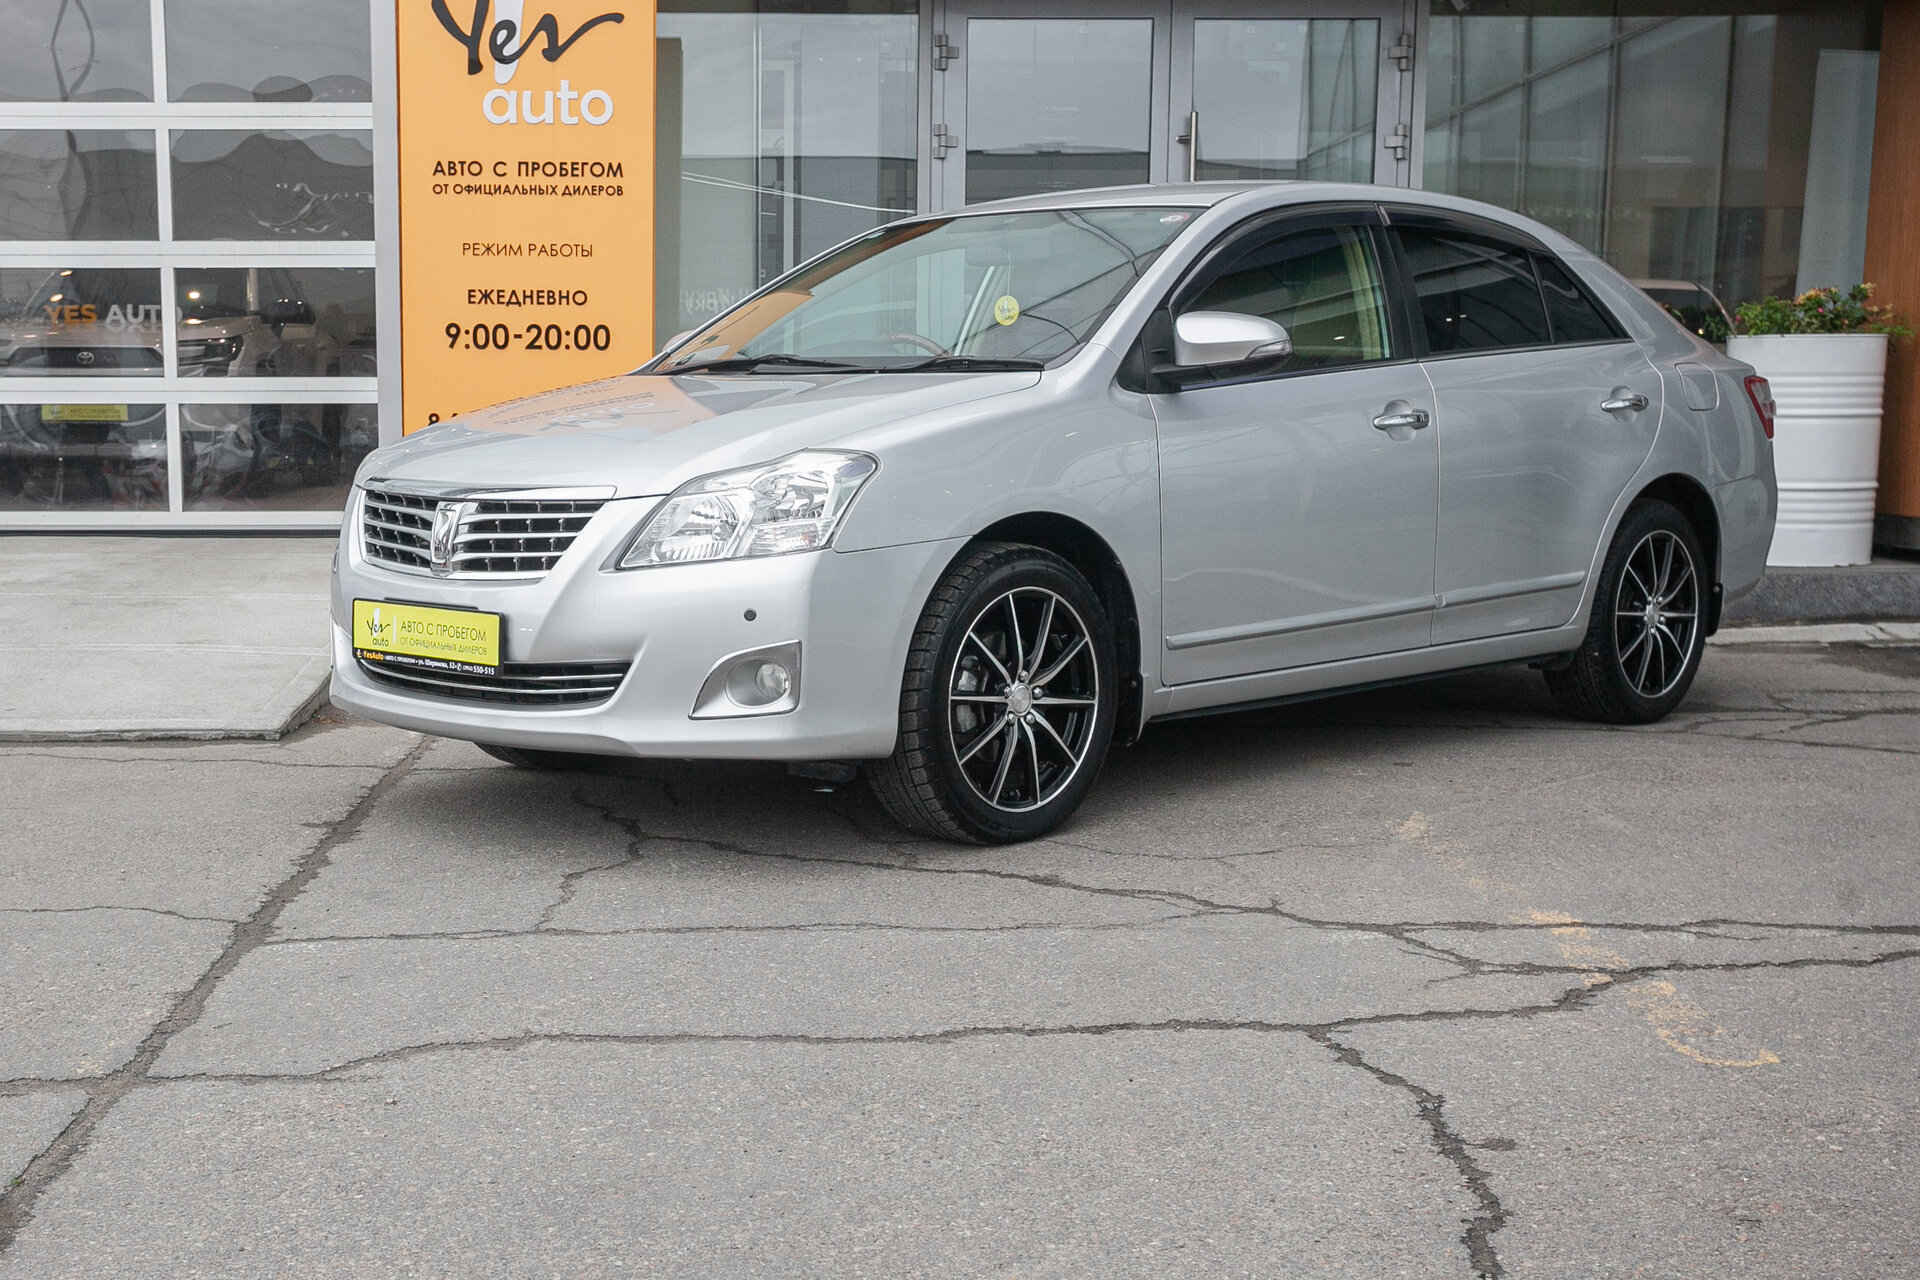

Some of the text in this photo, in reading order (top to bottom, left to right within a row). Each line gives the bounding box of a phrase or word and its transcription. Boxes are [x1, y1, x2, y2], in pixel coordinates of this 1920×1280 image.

[483, 79, 614, 125] auto
[432, 160, 624, 178] АВТО С ПРОБЕГОМ
[432, 183, 624, 197] ОТ ОФИЦИАЛЬНЫХ ДИЛЕРОВ
[462, 242, 593, 257] РЕЖИМ РАБОТЫ
[467, 289, 588, 307] ЕЖЕДНЕВНО
[44, 304, 98, 325] YES
[445, 322, 611, 351] 9:00-20:00
[366, 617, 390, 636] Yes
[401, 620, 487, 642] АВТО С ПРОБЕГОМ
[372, 637, 389, 647] auto
[400, 636, 408, 645] ОТ
[458, 644, 487, 656] ДИЛЕРОВ
